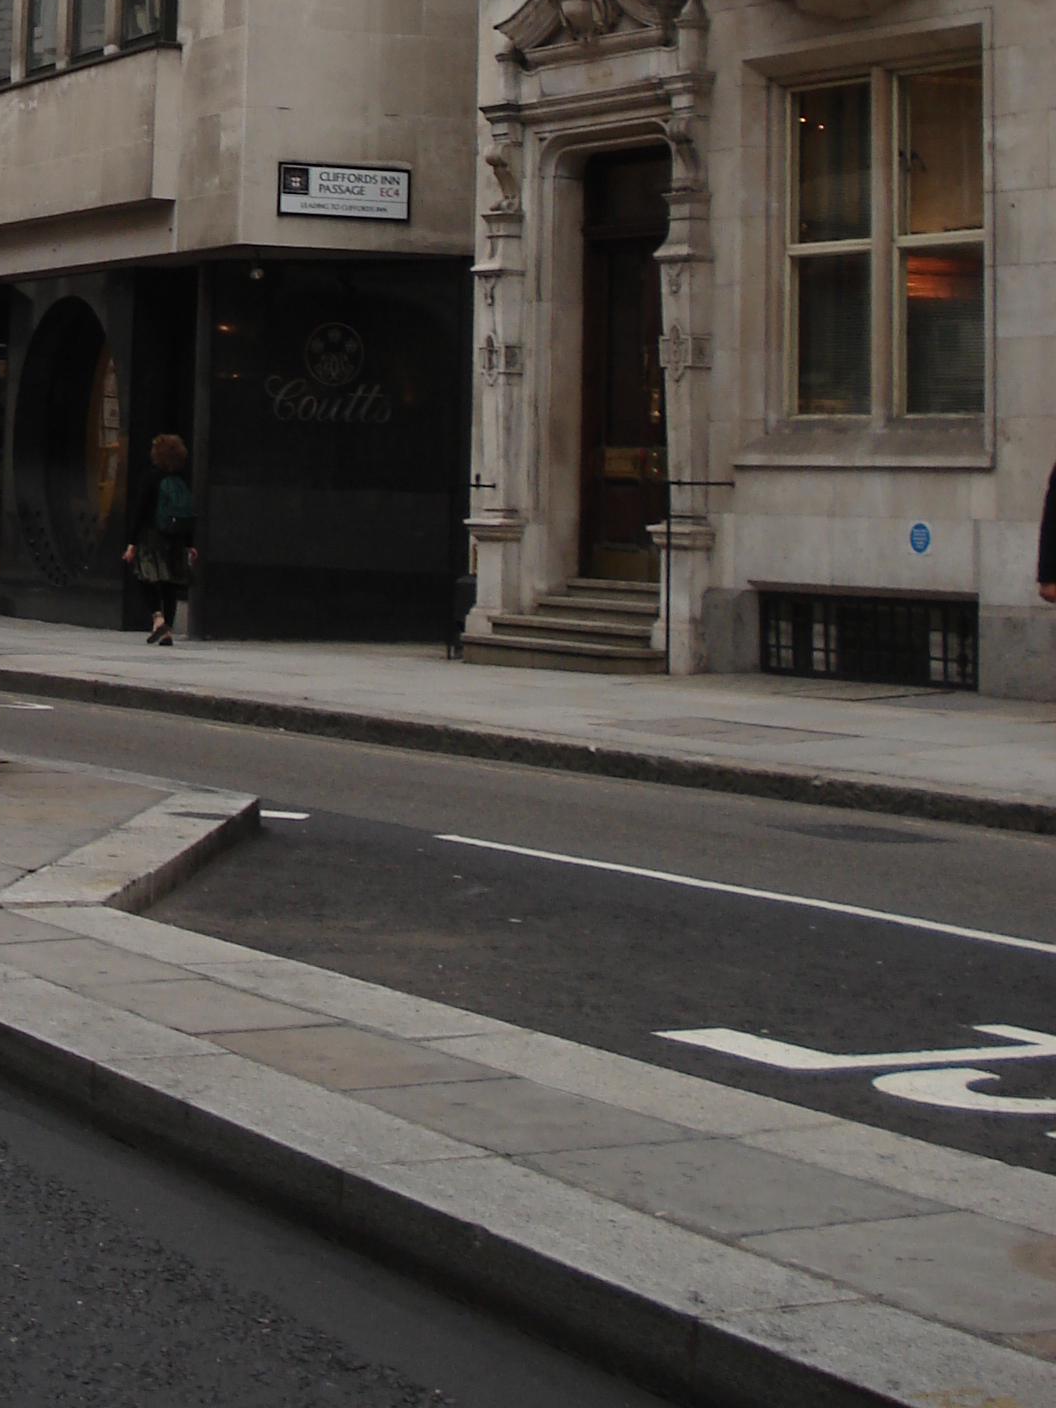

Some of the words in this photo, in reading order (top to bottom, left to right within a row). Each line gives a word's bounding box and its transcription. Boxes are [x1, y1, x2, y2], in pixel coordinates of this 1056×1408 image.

[319, 171, 379, 184] CLIFFORDS
[381, 175, 401, 186] INN
[319, 183, 365, 195] PASSAGE
[380, 187, 400, 197] EC4
[264, 374, 392, 423] Coutts
